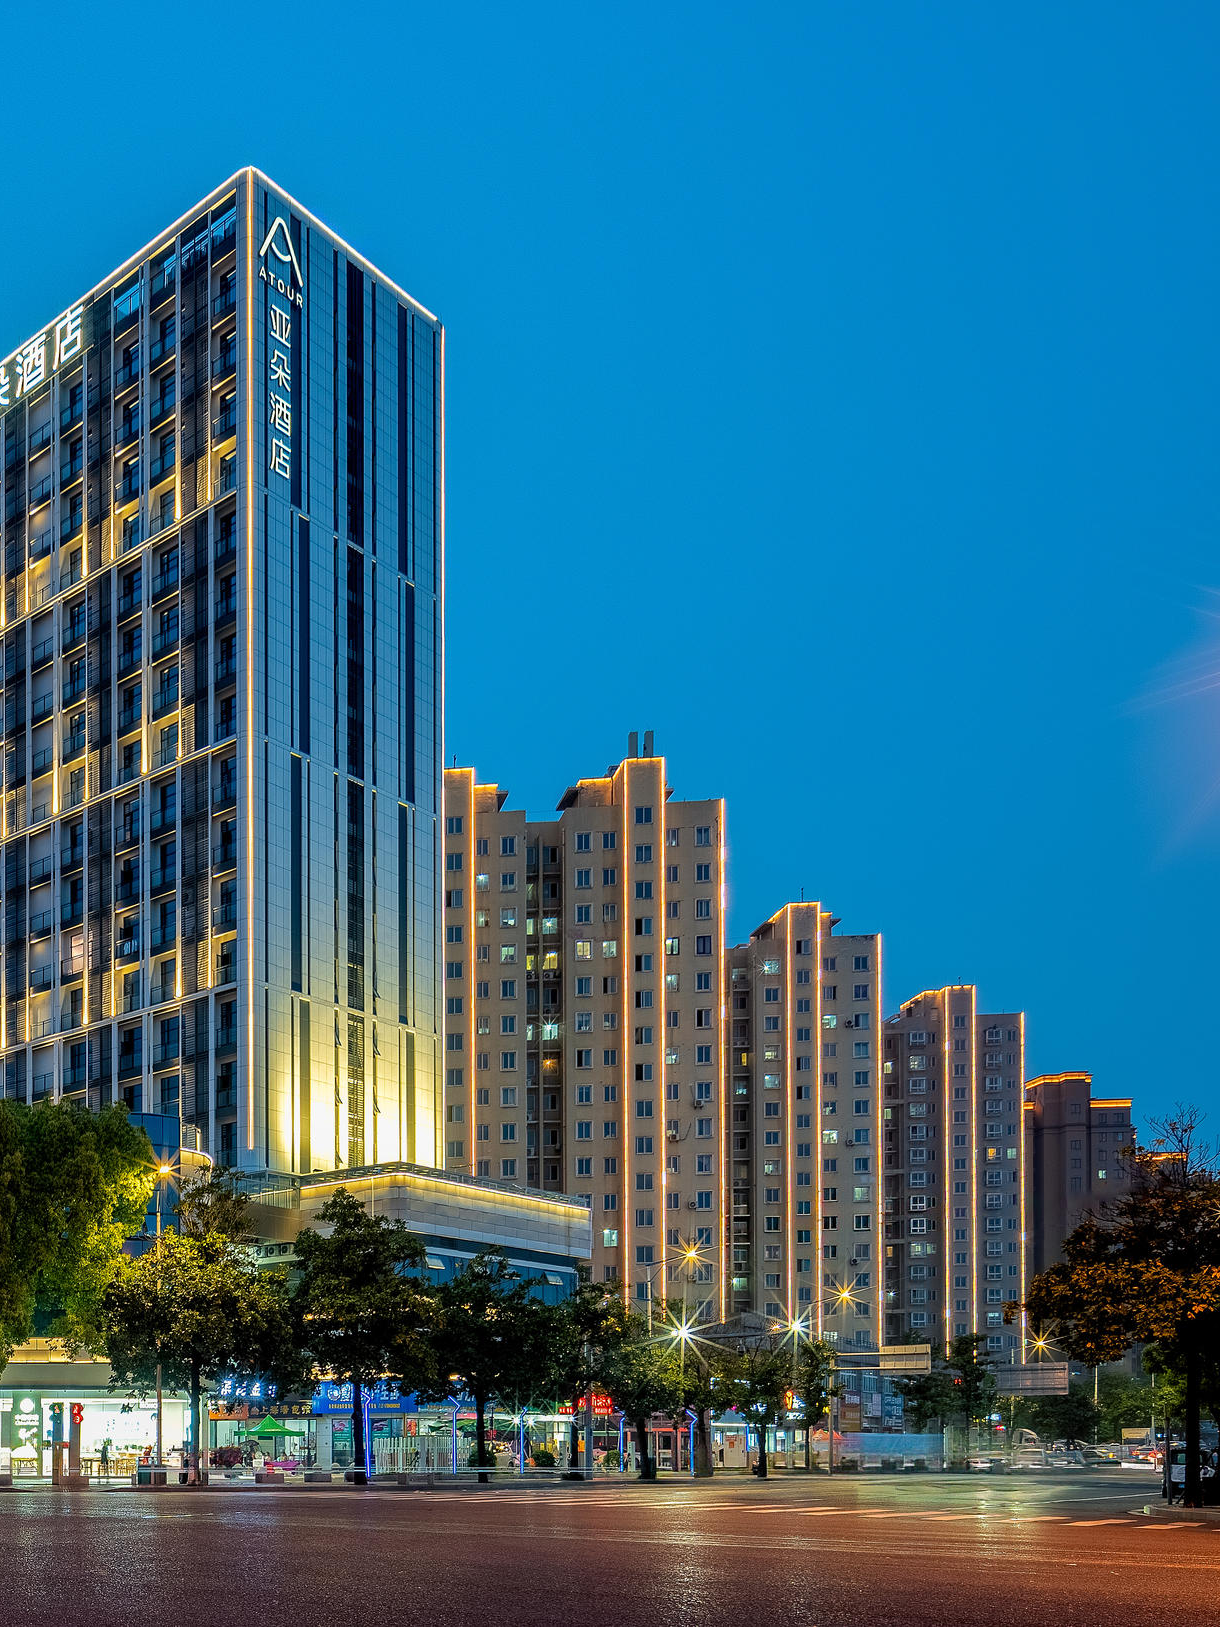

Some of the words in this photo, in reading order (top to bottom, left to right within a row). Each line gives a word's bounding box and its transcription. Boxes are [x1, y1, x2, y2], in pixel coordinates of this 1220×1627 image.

[259, 265, 304, 309] ATOUR
[269, 303, 292, 479] 亚朵酒店
